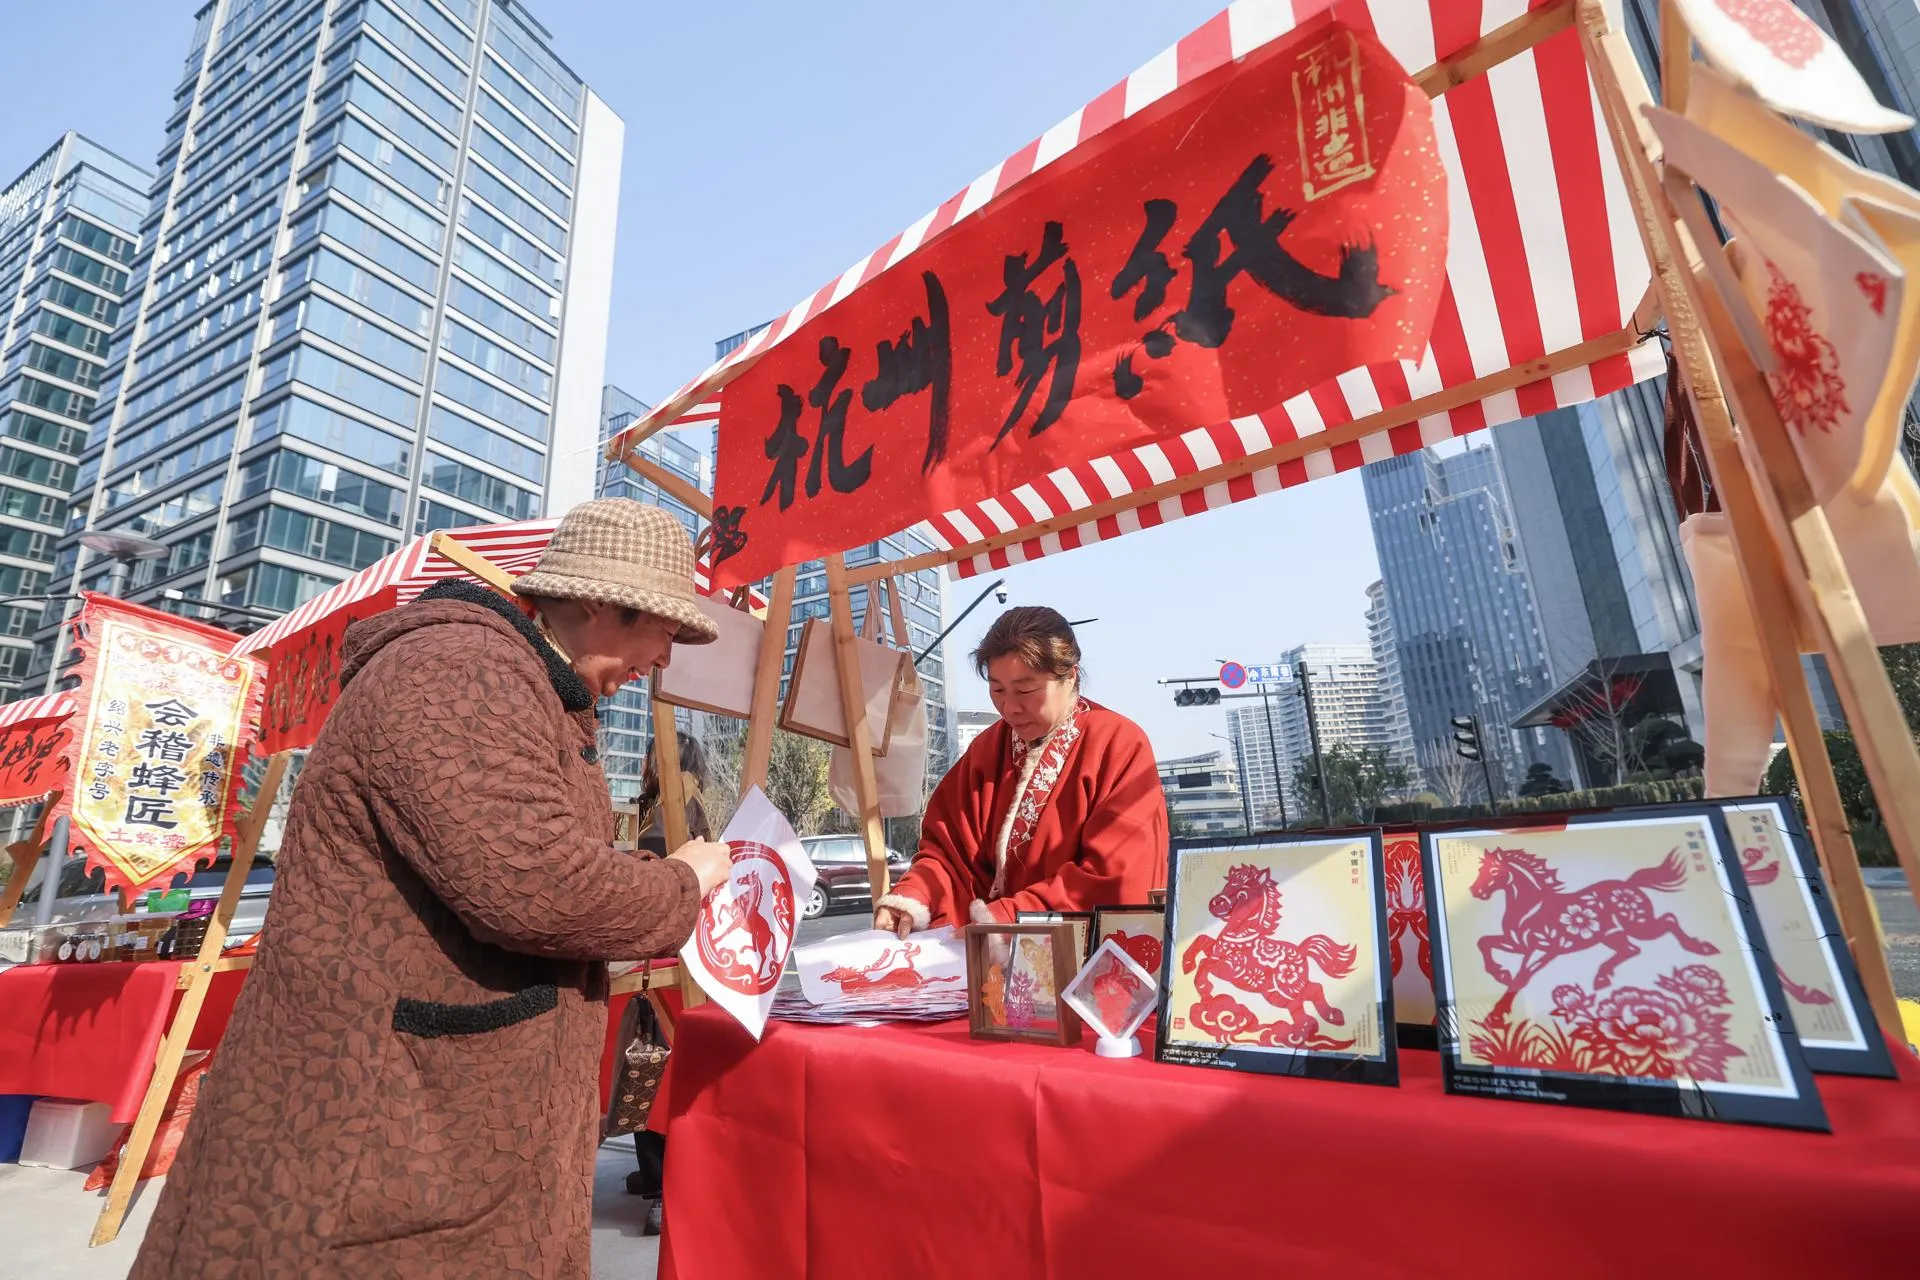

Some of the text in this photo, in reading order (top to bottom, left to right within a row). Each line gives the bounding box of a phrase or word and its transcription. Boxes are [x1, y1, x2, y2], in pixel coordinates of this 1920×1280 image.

[761, 154, 1400, 510] 杭州剪纸
[89, 700, 126, 800] 绍兴老字号
[125, 699, 199, 829] 会稽蜂匠
[106, 828, 188, 849] 土蜂蜜
